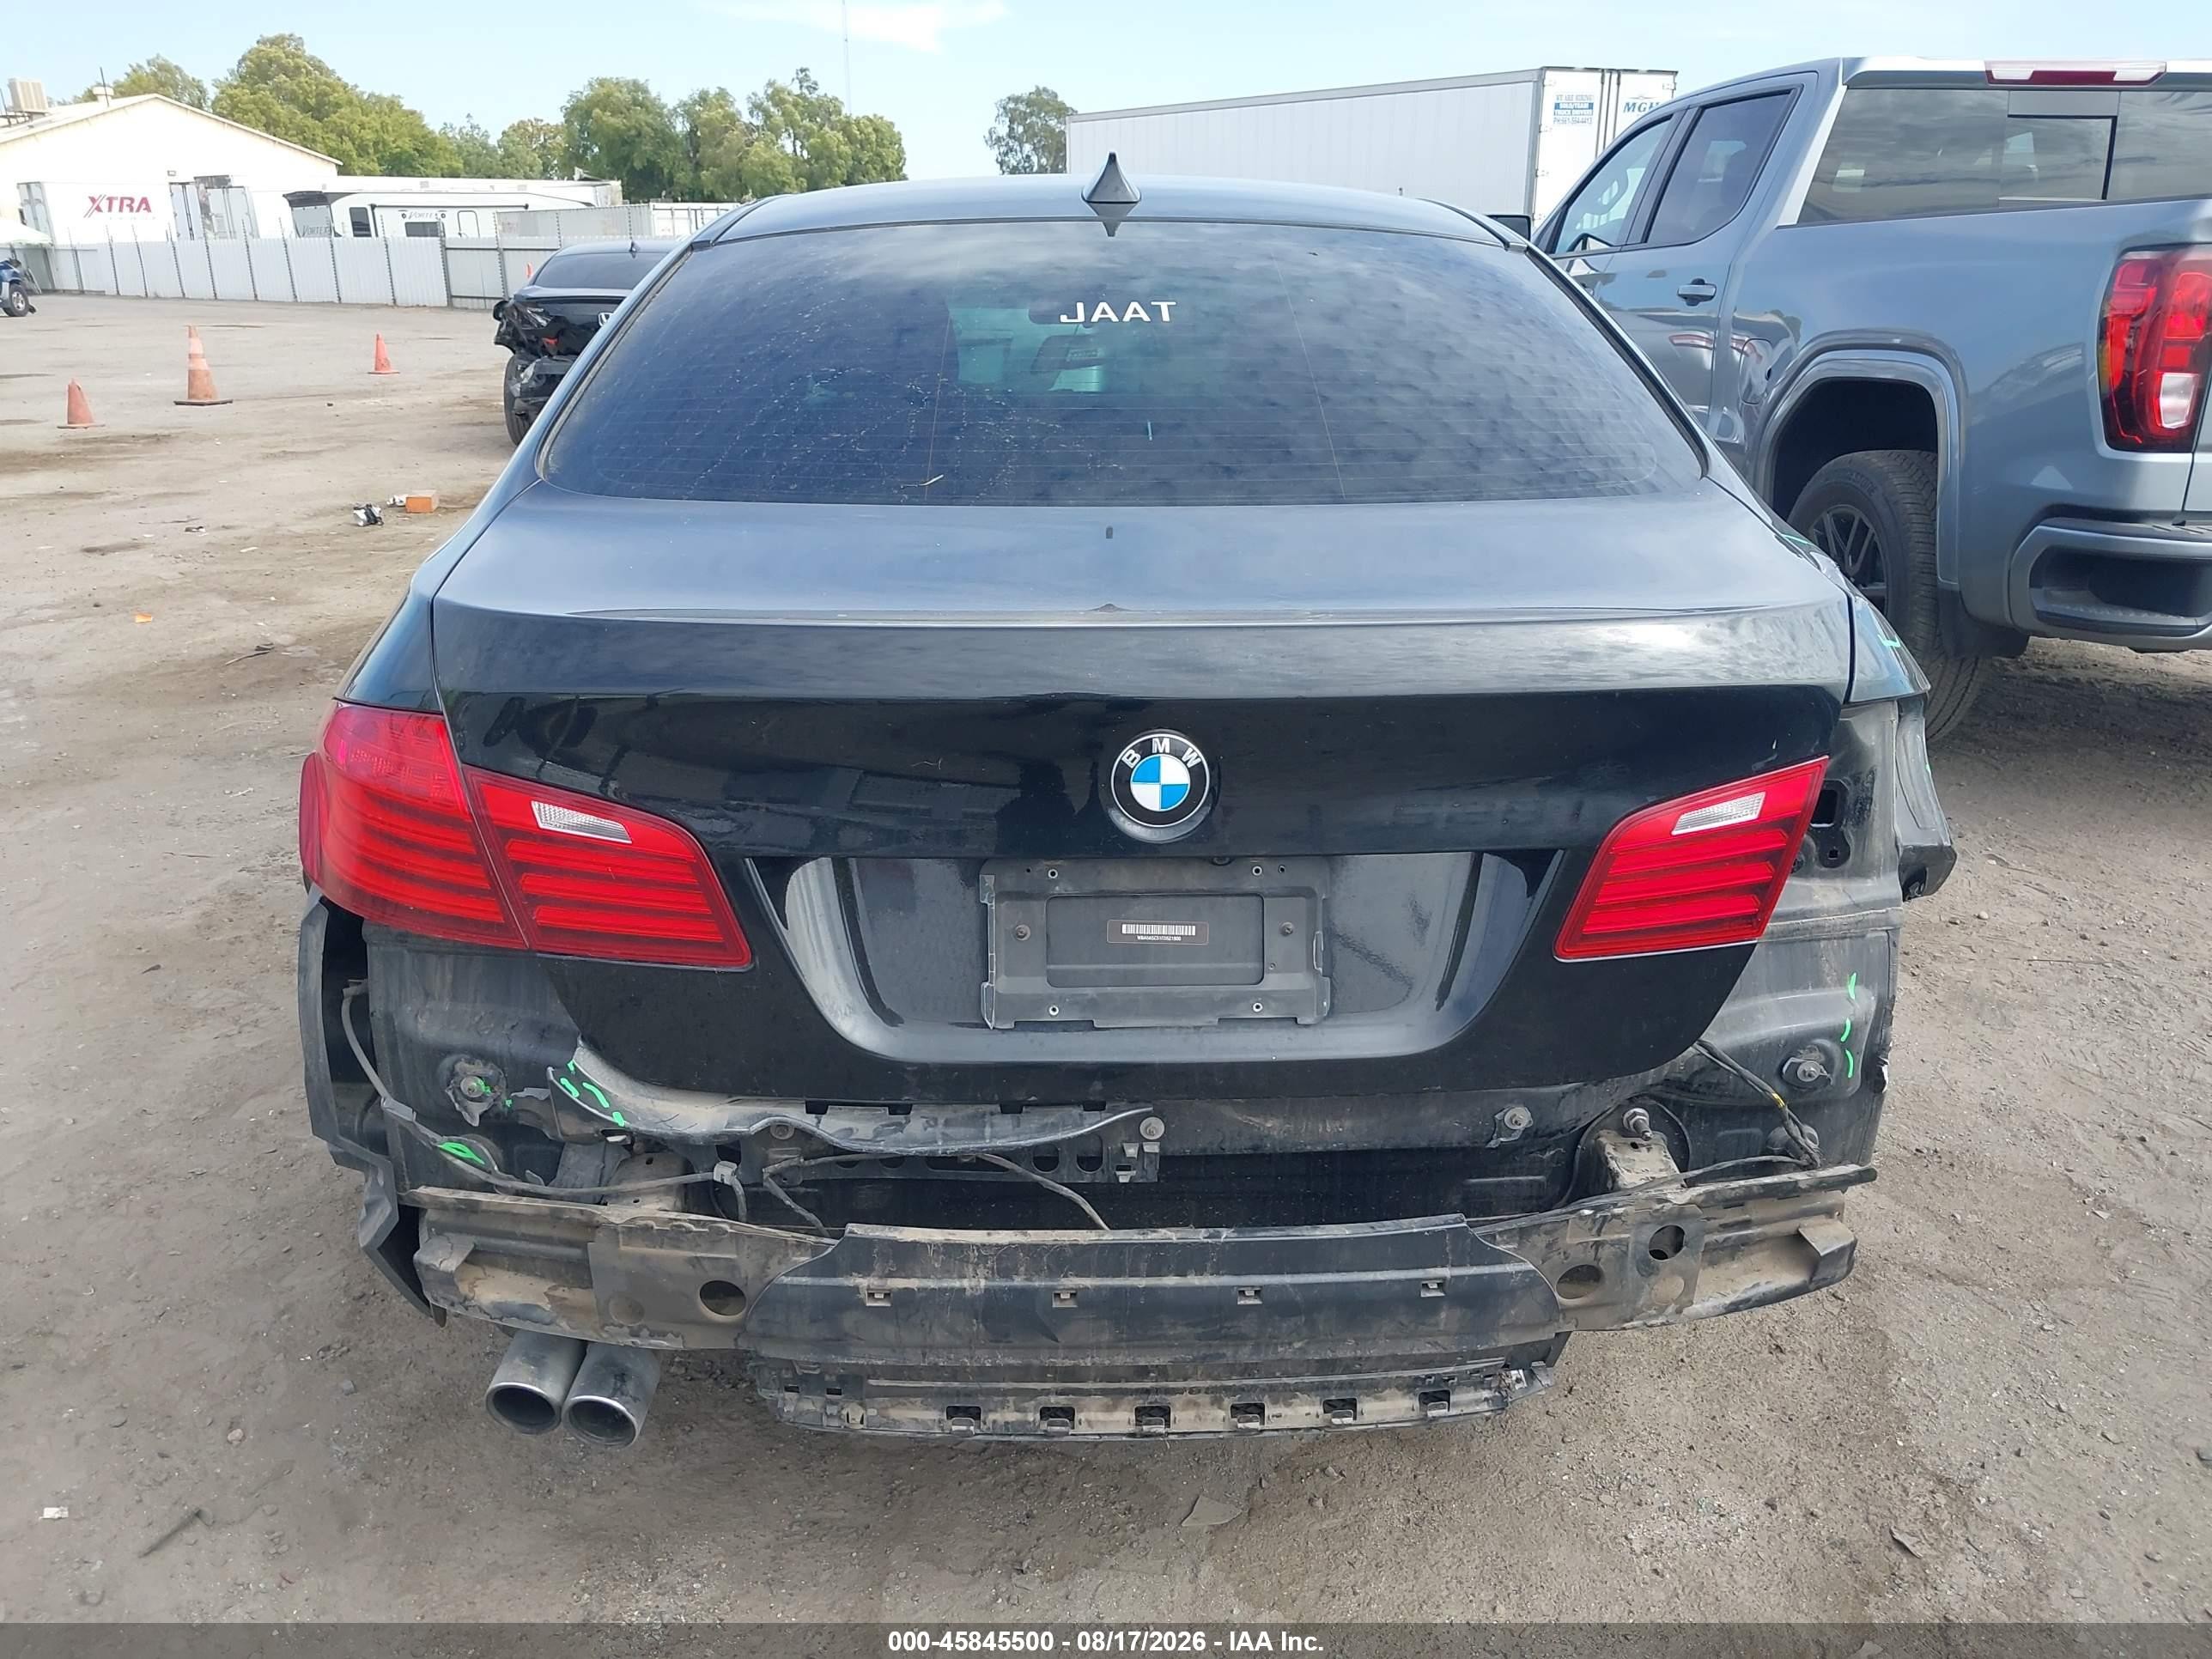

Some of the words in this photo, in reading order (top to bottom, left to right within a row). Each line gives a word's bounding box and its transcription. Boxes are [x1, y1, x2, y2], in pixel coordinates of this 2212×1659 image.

[83, 194, 152, 218] XTRA
[1060, 301, 1176, 323] JAAT
[1121, 738, 1201, 769] BMW
